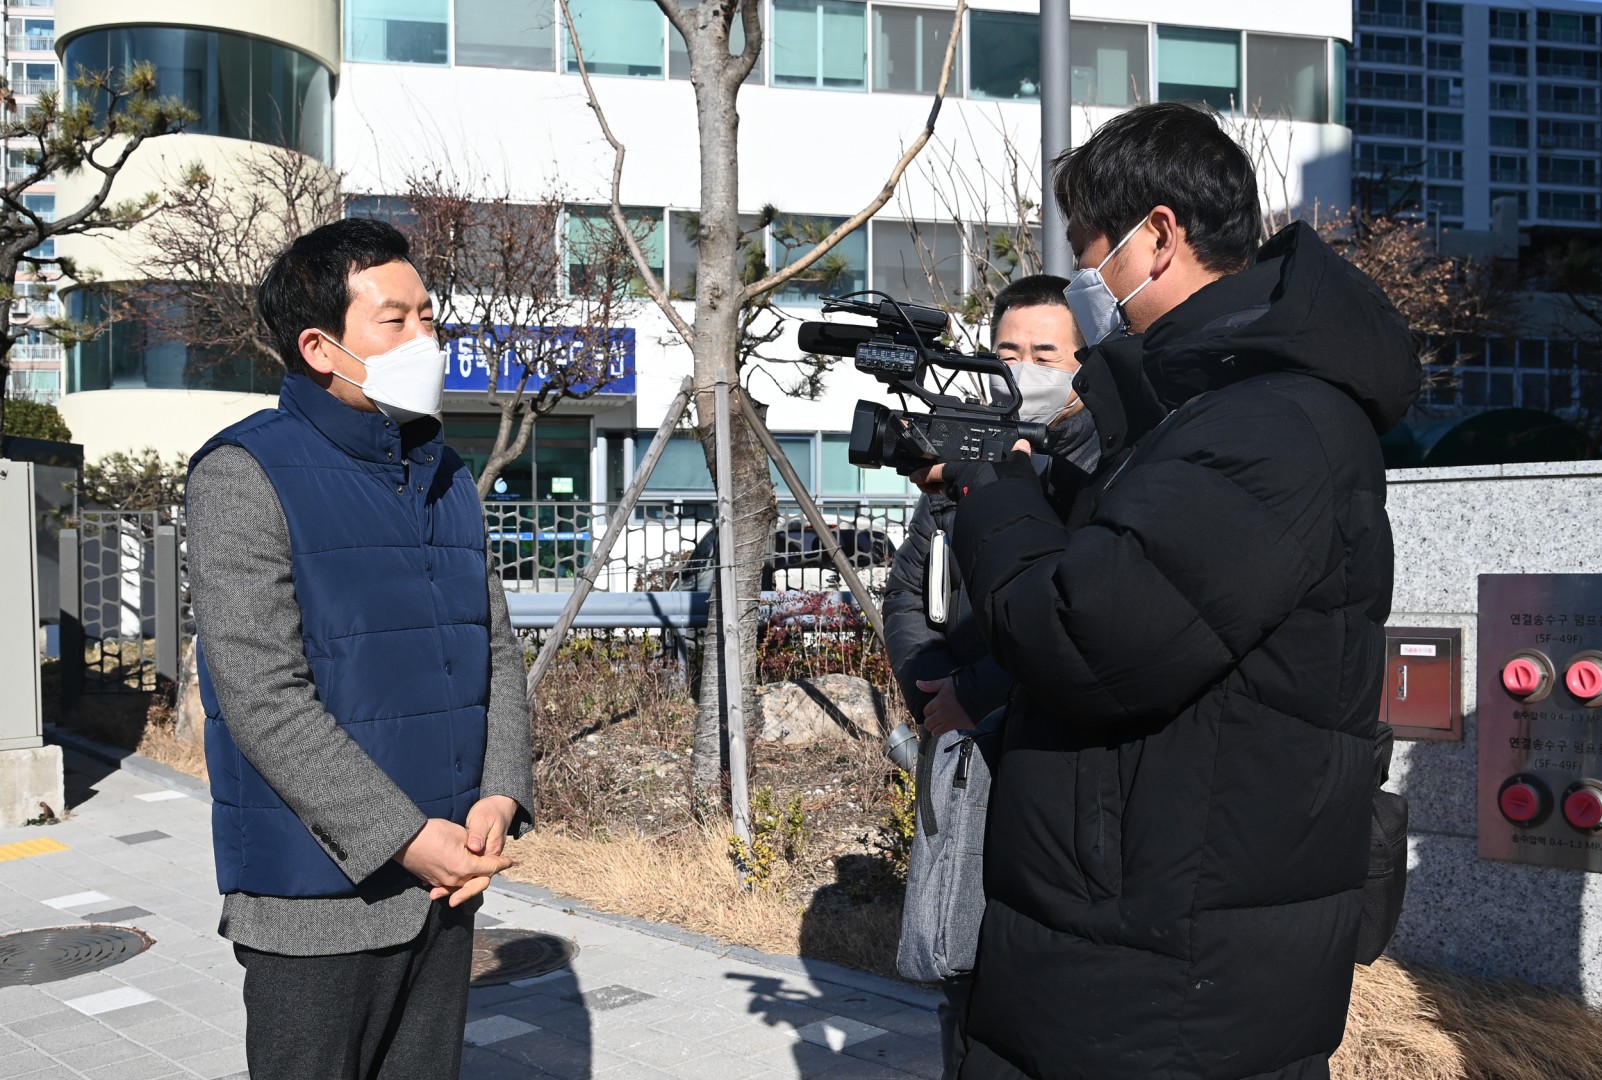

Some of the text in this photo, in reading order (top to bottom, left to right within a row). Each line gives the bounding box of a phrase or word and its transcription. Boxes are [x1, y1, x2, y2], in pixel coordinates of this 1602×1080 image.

[1510, 613, 1602, 627] 연결송수구 펌프
[1512, 710, 1547, 721] 송수압력
[1586, 714, 1602, 723] MP
[1509, 737, 1602, 755] 연결송수구 펌프
[1512, 834, 1546, 846] 송수압력
[1585, 841, 1602, 851] MP
